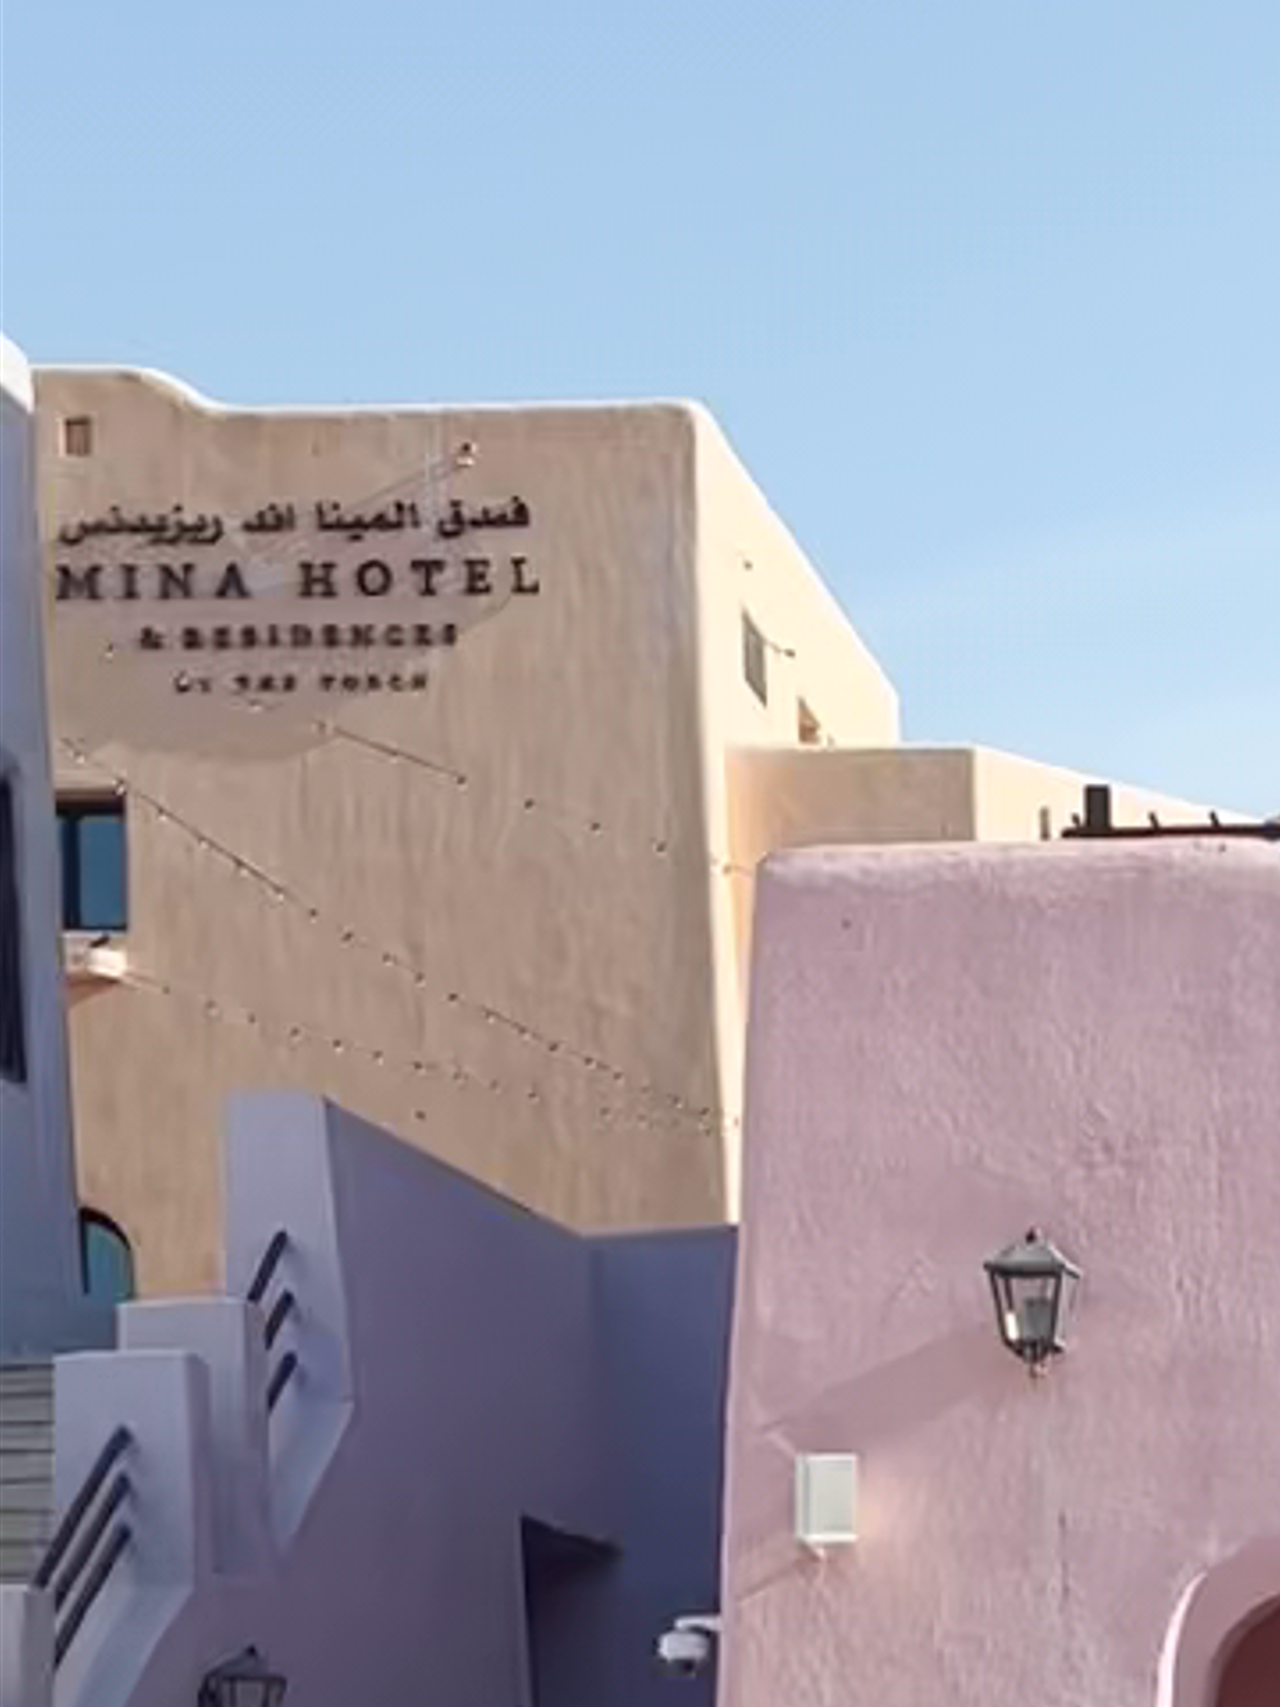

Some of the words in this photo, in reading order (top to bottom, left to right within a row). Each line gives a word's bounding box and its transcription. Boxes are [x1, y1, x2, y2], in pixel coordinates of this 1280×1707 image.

[55, 561, 252, 601] MINA
[297, 556, 541, 598] HOTEL
[139, 625, 166, 651] &
[181, 622, 458, 651] RESIDENCES
